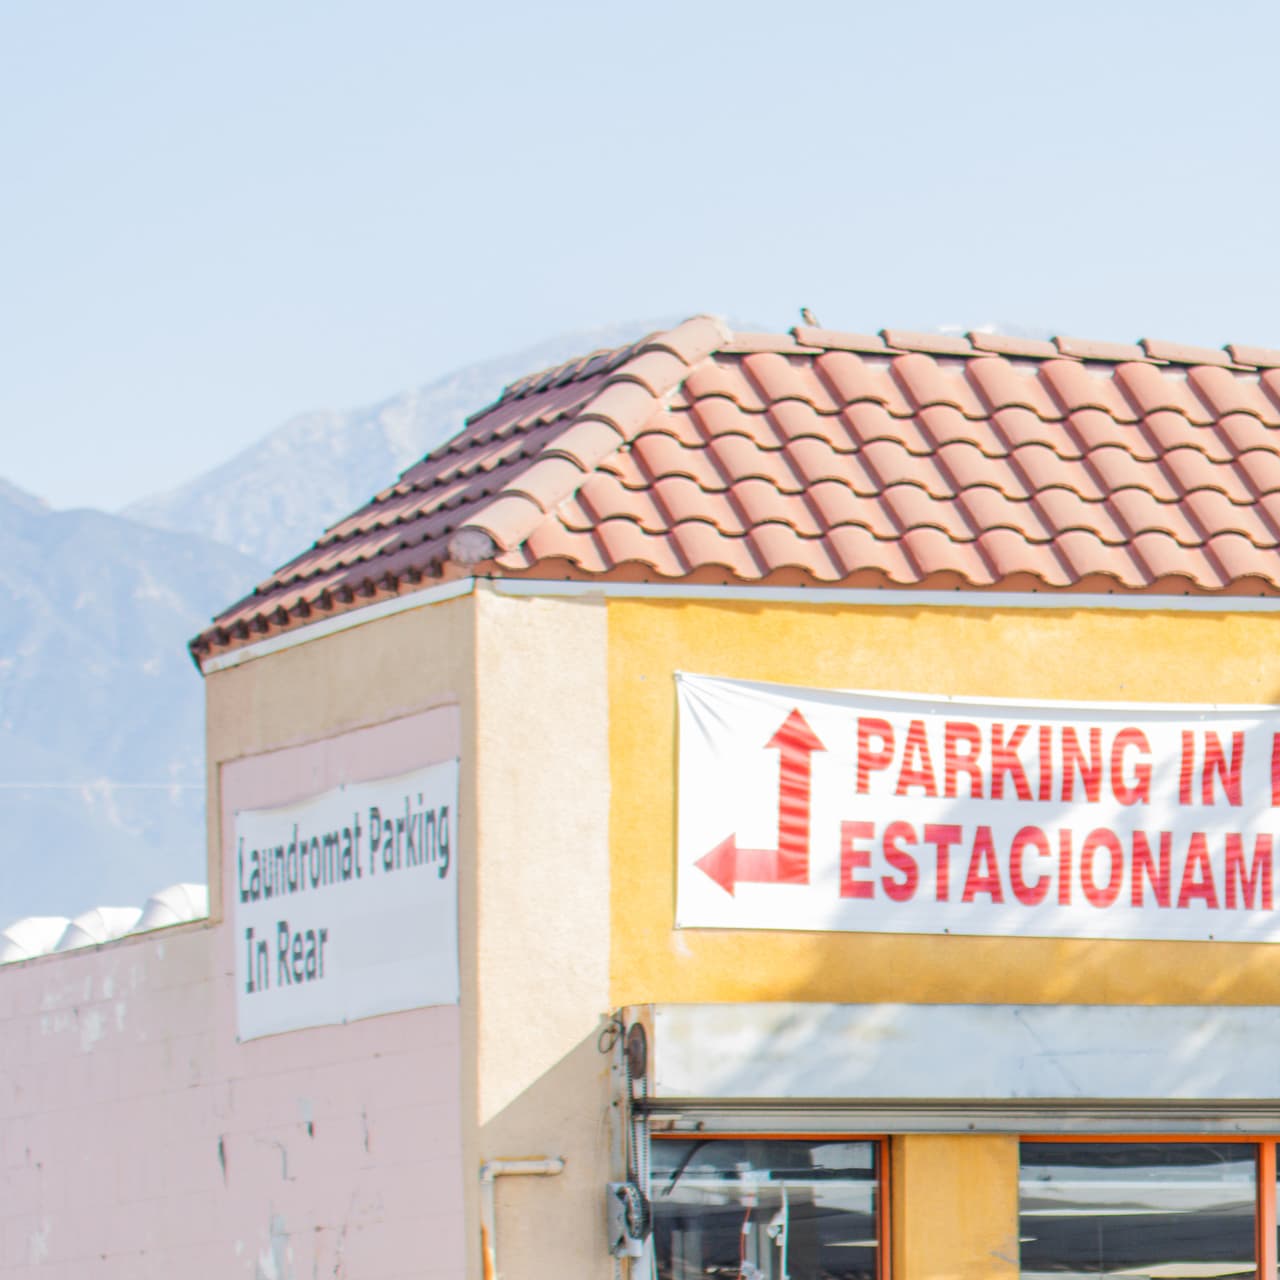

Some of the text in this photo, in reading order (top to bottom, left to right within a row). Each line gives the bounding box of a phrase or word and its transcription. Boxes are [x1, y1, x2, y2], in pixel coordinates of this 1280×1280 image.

[855, 716, 1153, 807] PARKING
[1179, 730, 1245, 808] IN
[238, 792, 450, 903] Laundromat Parking
[245, 919, 328, 994] In Rear
